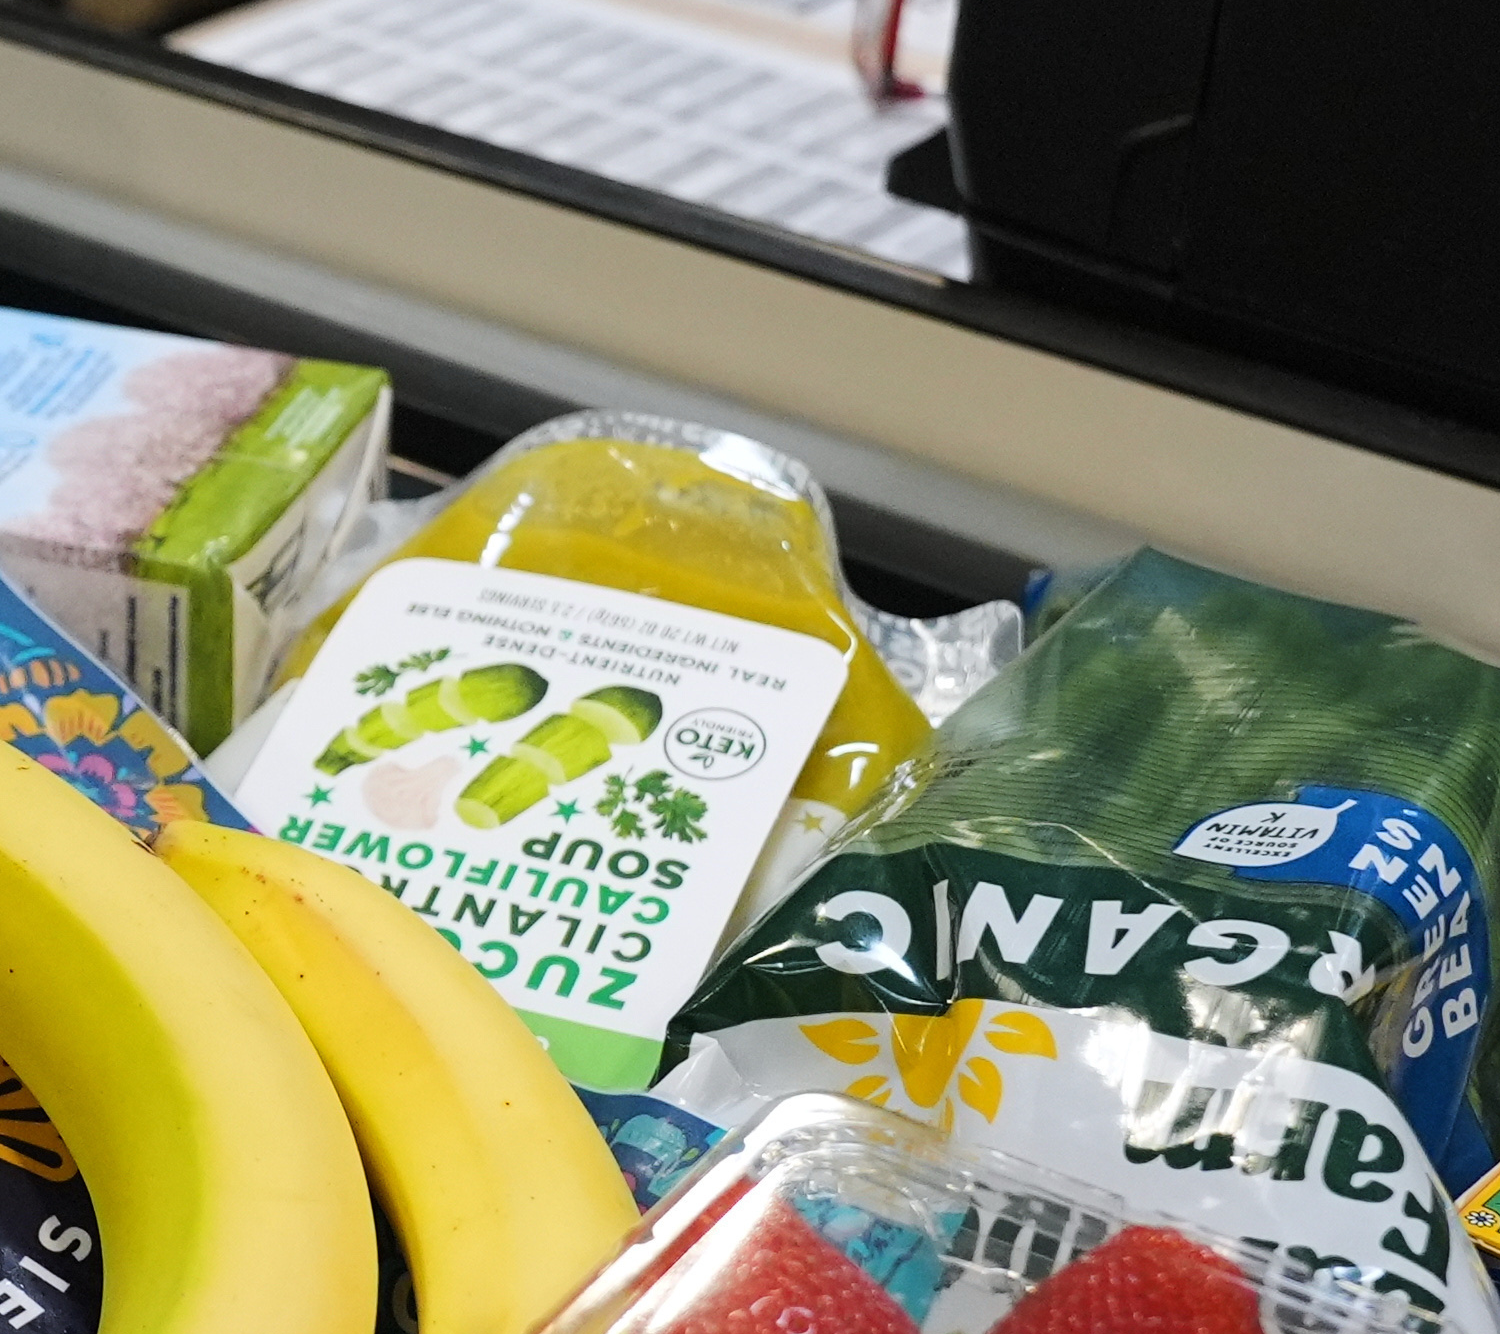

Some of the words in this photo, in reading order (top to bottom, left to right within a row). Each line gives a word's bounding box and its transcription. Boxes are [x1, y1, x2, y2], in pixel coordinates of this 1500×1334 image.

[406, 602, 452, 620] ELSE
[456, 611, 552, 638] NOTHING
[558, 628, 574, 642] &
[481, 635, 682, 687] NUTRIENT-DENSE
[579, 633, 721, 676] INGREDIENTS
[728, 666, 788, 692] REAL
[689, 716, 755, 740] FRIENDLY
[675, 729, 756, 761] KETO
[1205, 820, 1321, 840] VITAMIN
[1260, 810, 1288, 824] K
[1202, 841, 1293, 858] EXCELLENT
[1207, 835, 1233, 845] OF
[1235, 838, 1299, 849] SOURCE
[276, 813, 671, 925] CAULIFLOWER
[521, 830, 692, 891] SOUP
[352, 861, 652, 964] CILANTR
[814, 877, 1376, 1005] RGANIC
[1375, 817, 1479, 1039] BEANS
[1347, 842, 1446, 1060] GREEN
